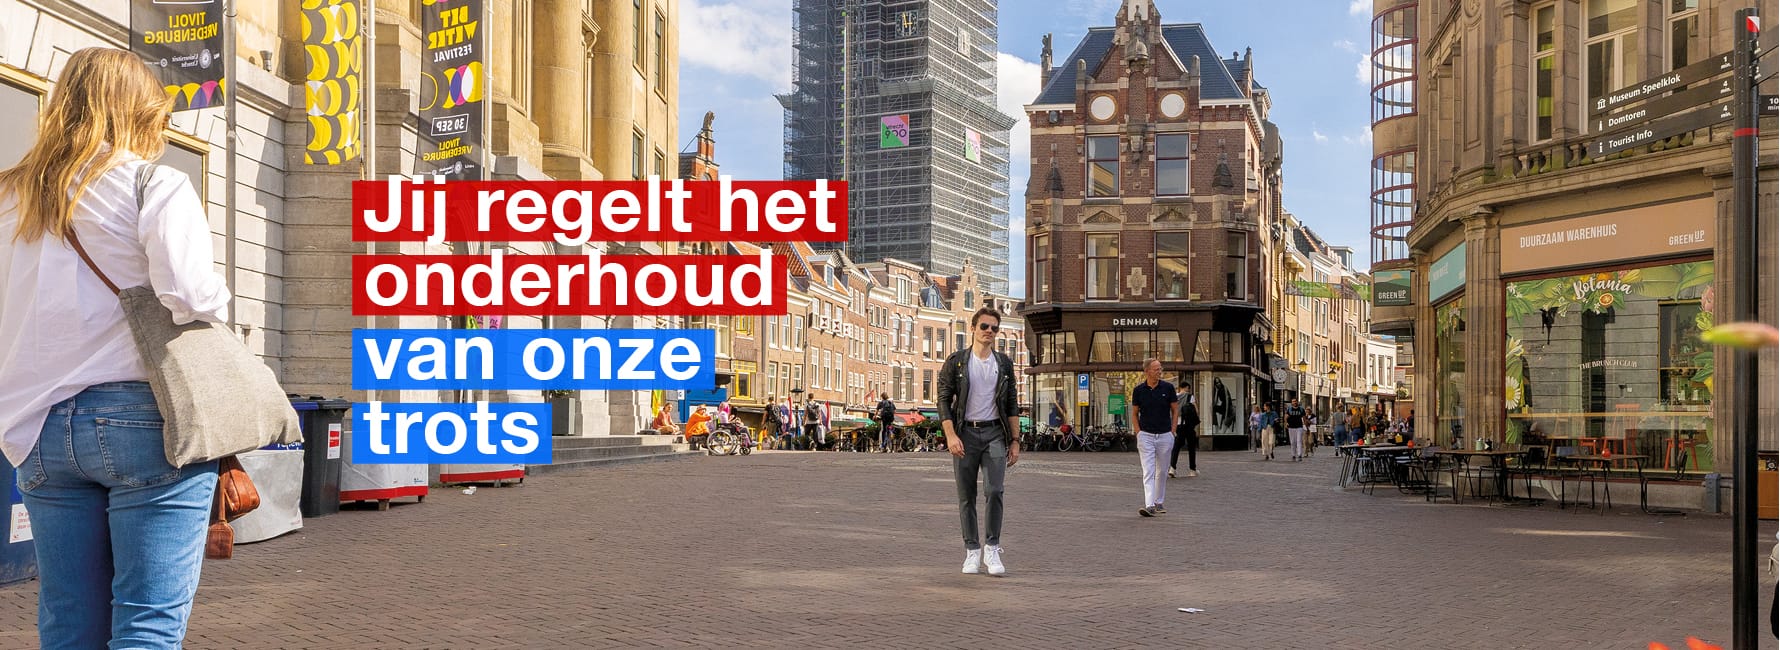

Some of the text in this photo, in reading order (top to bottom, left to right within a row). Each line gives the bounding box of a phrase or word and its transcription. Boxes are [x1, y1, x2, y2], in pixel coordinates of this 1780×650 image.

[1609, 73, 1681, 104] Museum Speelklok
[1608, 109, 1646, 127] Domtoren
[1608, 129, 1653, 149] Tourist Info
[1520, 224, 1617, 248] DUURZAAM WARENHUIS
[1573, 275, 1632, 300] Botania
[1113, 318, 1158, 326] DENHAM
[1591, 359, 1619, 368] BRUNCH
[1619, 359, 1638, 368] CLUB
[1080, 375, 1087, 384] P
